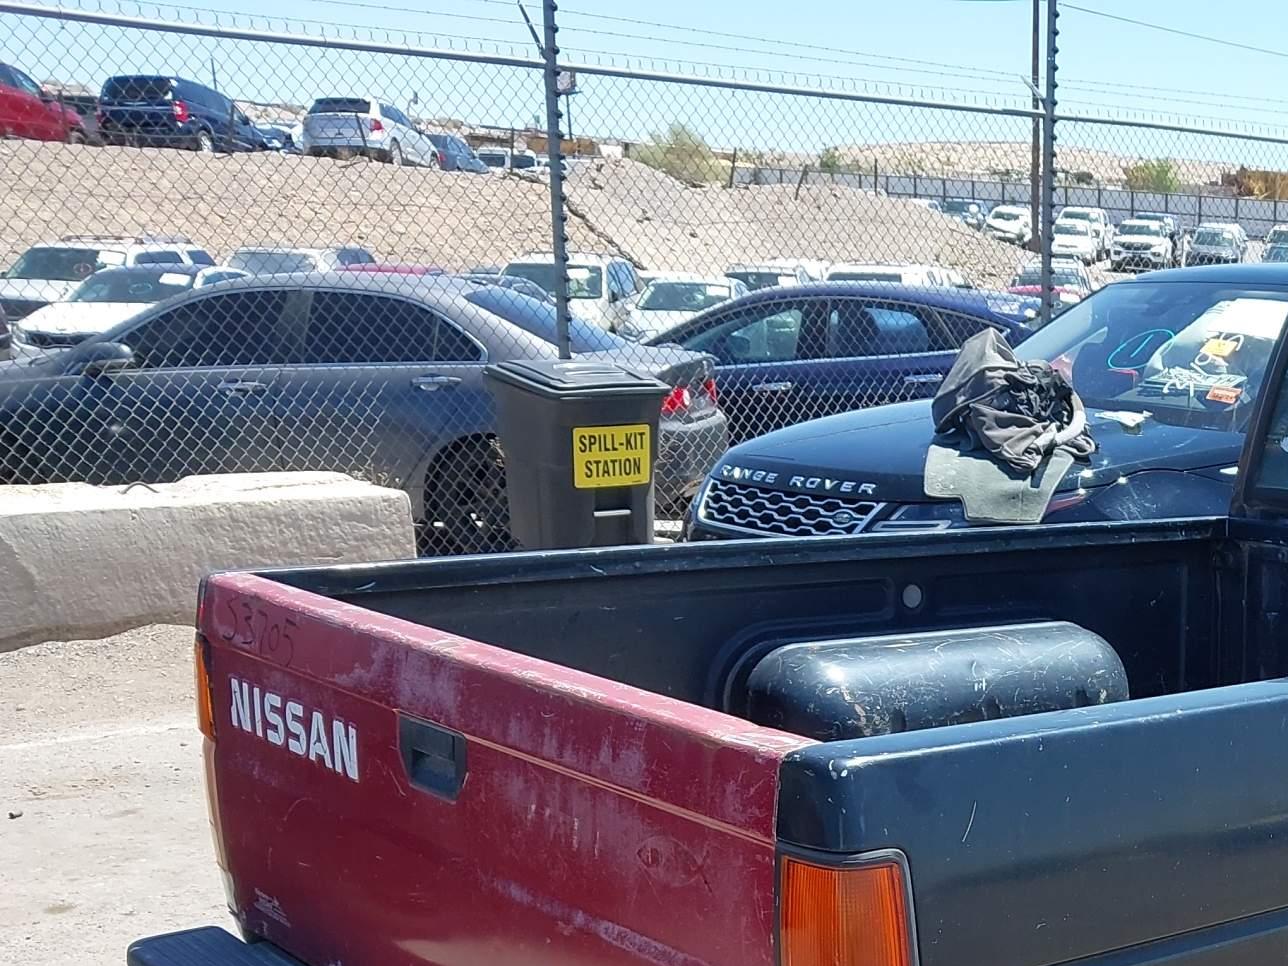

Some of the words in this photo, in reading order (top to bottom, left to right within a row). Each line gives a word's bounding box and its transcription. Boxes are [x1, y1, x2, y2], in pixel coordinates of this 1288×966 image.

[578, 431, 646, 453] SPILL-KIT
[584, 457, 641, 478] STATION
[719, 464, 779, 484] RANGE
[789, 475, 877, 495] ROVER
[230, 677, 360, 781] NISSAN
